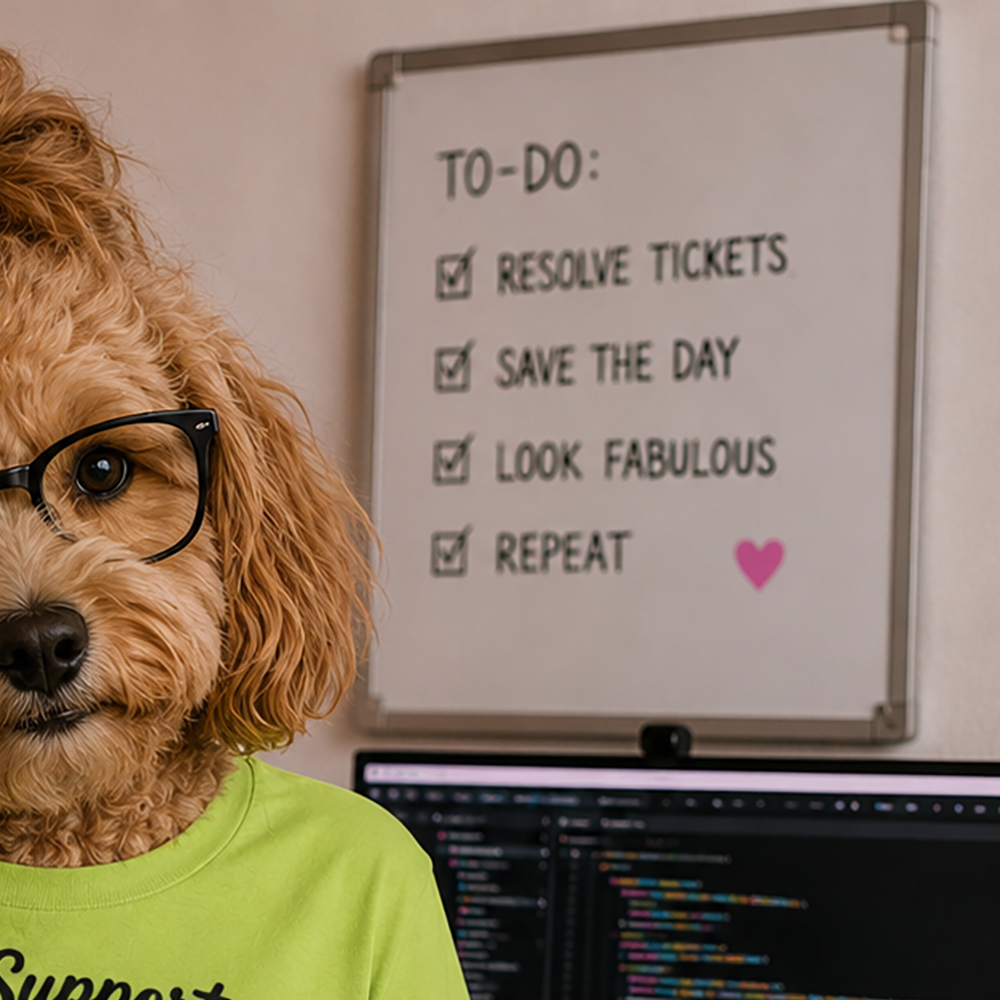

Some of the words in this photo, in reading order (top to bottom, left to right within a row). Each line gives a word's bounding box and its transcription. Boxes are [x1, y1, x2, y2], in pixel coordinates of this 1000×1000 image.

[437, 139, 600, 200] TO-DO:
[497, 244, 631, 295] RESOLVE
[648, 233, 788, 283] TICKETS
[495, 345, 575, 389] SAVE
[589, 341, 653, 384] THE
[673, 336, 740, 382] DAY
[496, 441, 583, 483] LOOK
[604, 436, 777, 480] FABULOUS
[496, 531, 632, 574] REPEAT
